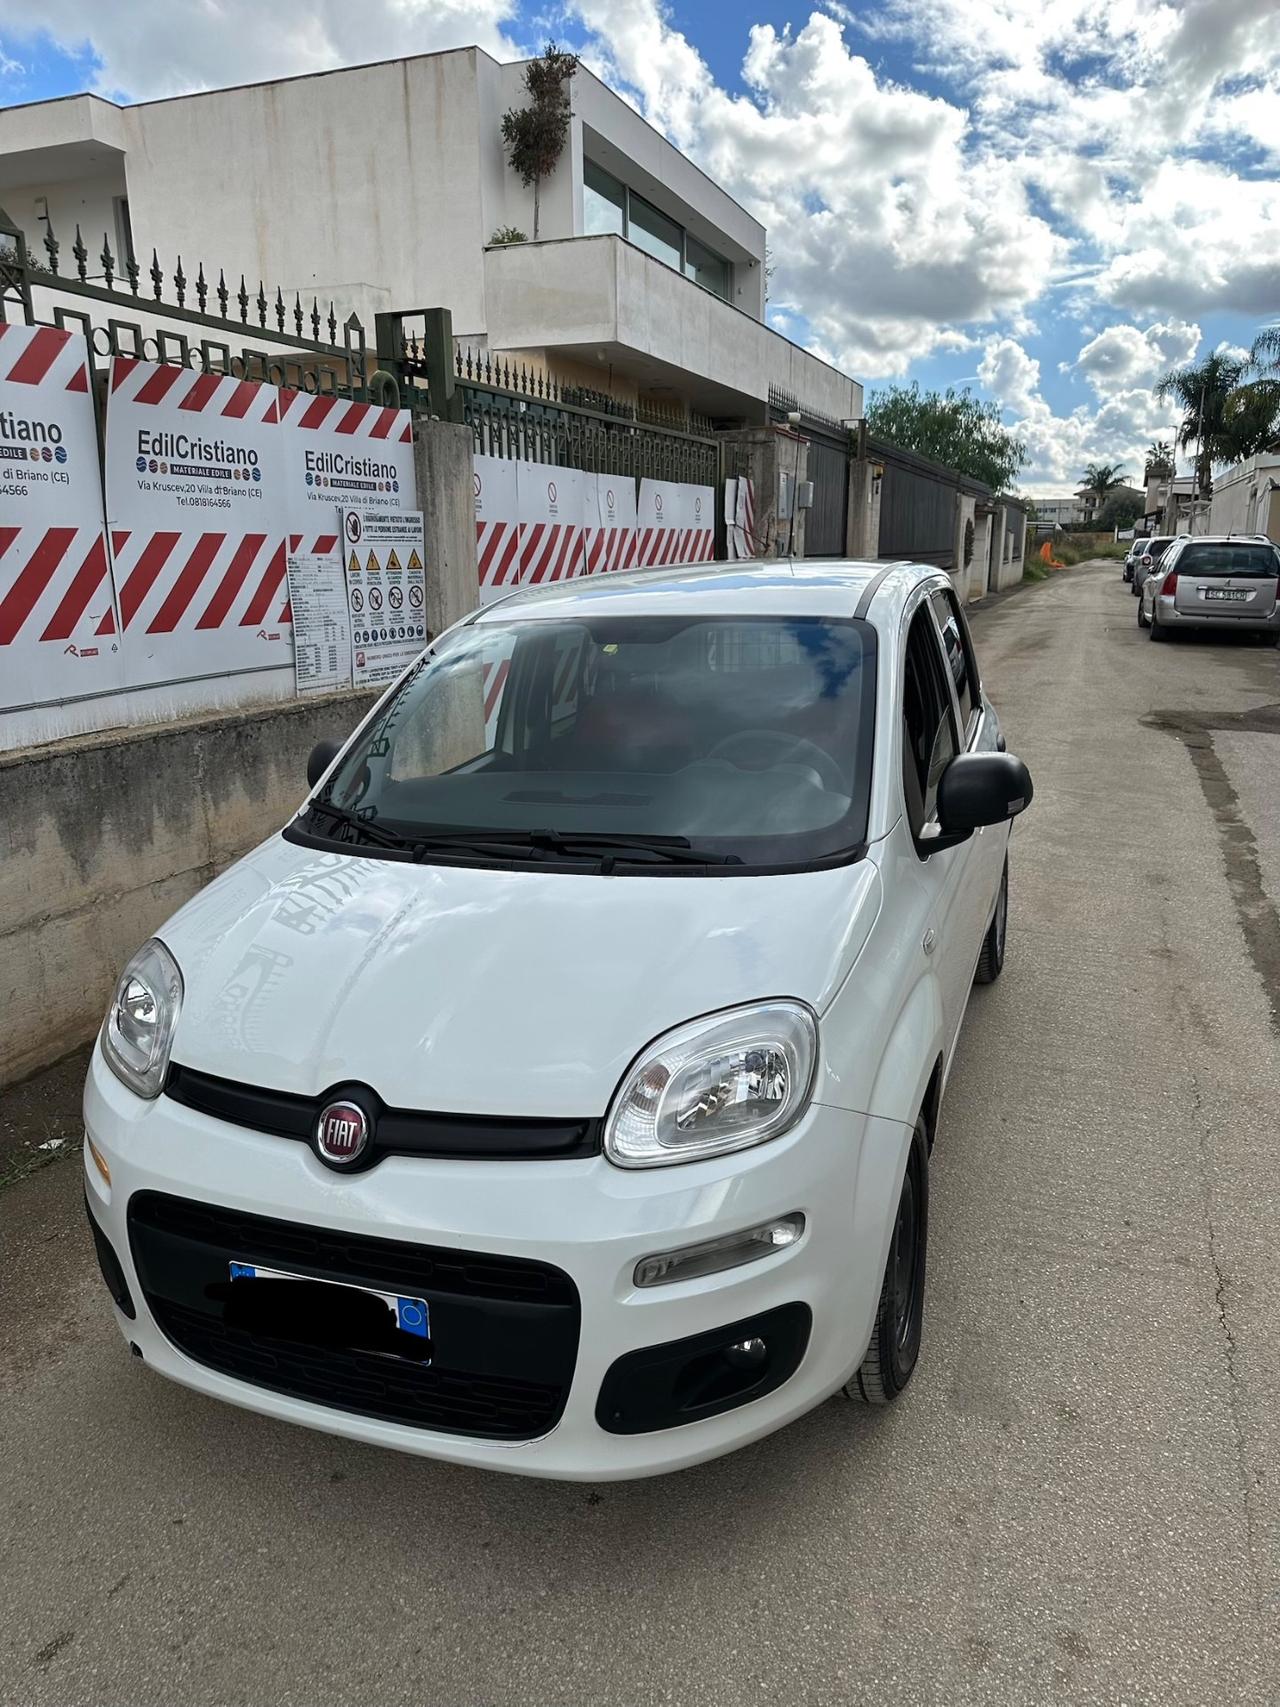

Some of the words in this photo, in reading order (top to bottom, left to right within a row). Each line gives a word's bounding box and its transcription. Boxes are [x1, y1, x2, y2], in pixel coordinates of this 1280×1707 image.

[138, 429, 259, 466] EdilCristiano
[173, 465, 210, 477] MATERIALE
[211, 468, 230, 478] EDILE
[304, 450, 397, 479] EdilCristiano
[3, 468, 14, 480] di
[16, 469, 49, 482] Briano
[51, 471, 69, 485] (CE)
[0, 485, 28, 496] 4566
[137, 480, 151, 491] Via
[197, 485, 213, 495] Villa
[222, 486, 247, 497] Briano
[248, 487, 263, 499] (CE)
[307, 492, 317, 501] Via
[368, 496, 389, 506] Briano
[326, 1118, 358, 1148] FIAT
